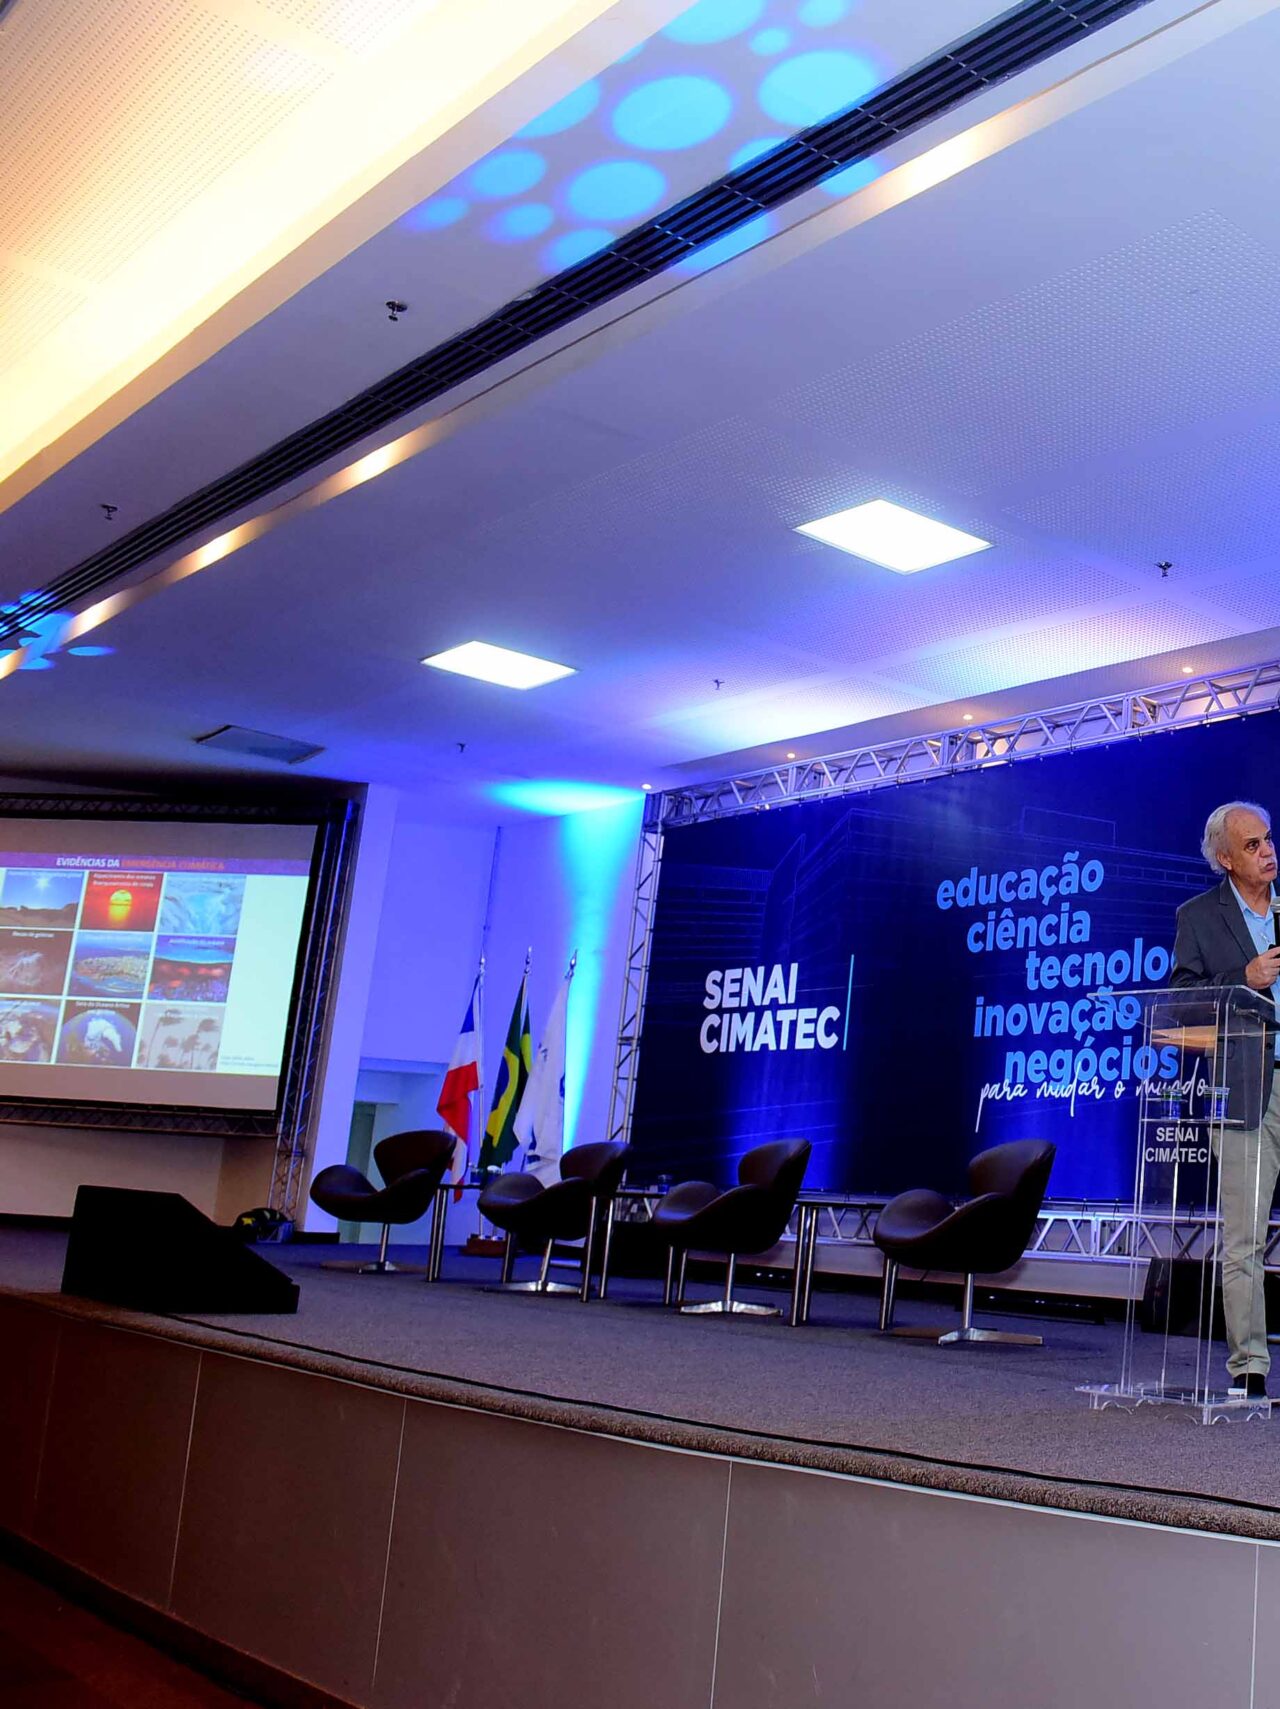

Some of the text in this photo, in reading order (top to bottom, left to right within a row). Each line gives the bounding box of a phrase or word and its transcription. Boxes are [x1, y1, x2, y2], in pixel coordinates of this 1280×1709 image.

[56, 856, 105, 868] EVIDÊNCIAS
[107, 858, 121, 868] DA
[937, 851, 1104, 910] educação
[967, 902, 1091, 953] ciência
[703, 963, 798, 1010] SENAI
[1026, 938, 1176, 990] tecnolo
[700, 1006, 841, 1054] CIMATEC
[974, 986, 1141, 1041] inovação
[1004, 1036, 1179, 1090] negócios
[975, 1057, 1209, 1133] para mudar o mundo
[1145, 1147, 1208, 1163] CIMATEC
[1156, 1127, 1199, 1142] SENAI
